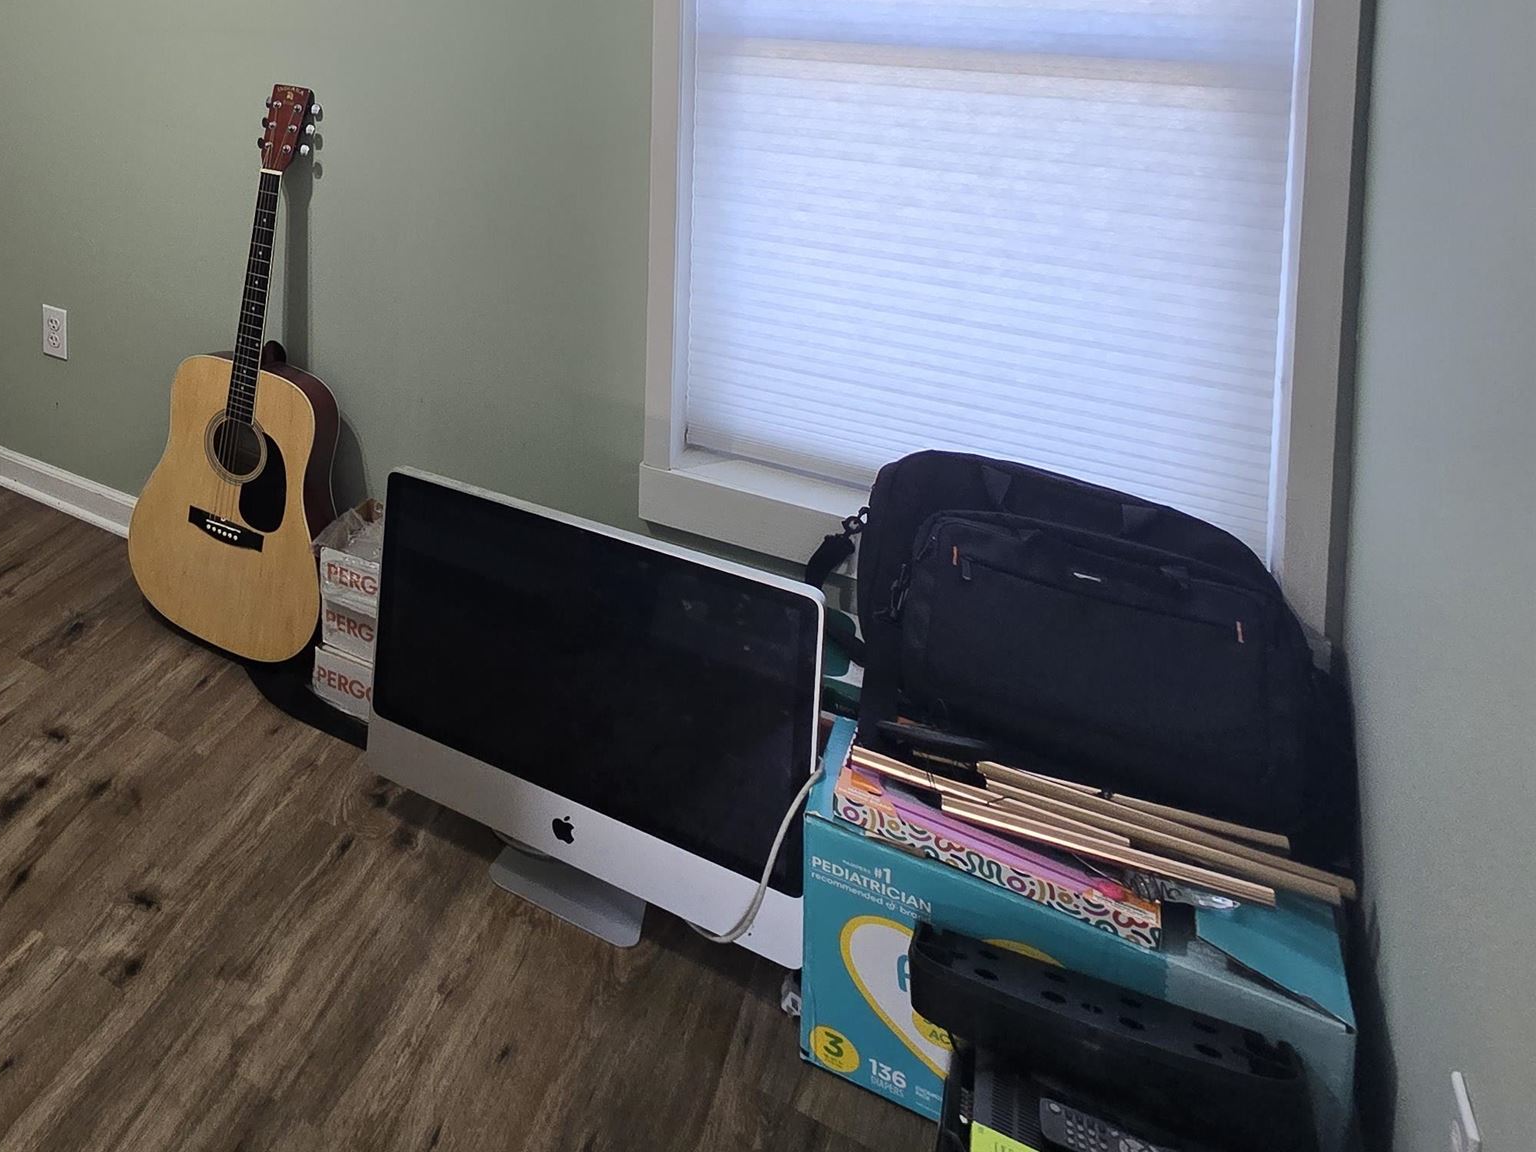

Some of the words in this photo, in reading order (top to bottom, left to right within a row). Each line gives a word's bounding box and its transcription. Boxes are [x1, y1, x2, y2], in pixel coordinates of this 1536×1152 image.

[811, 856, 932, 913] PEDIATRICIAN
[811, 872, 884, 905] recommended
[874, 867, 891, 884] #1
[823, 1031, 844, 1058] 3
[869, 1059, 907, 1088] 136
[870, 1075, 905, 1098] DIAPERS
